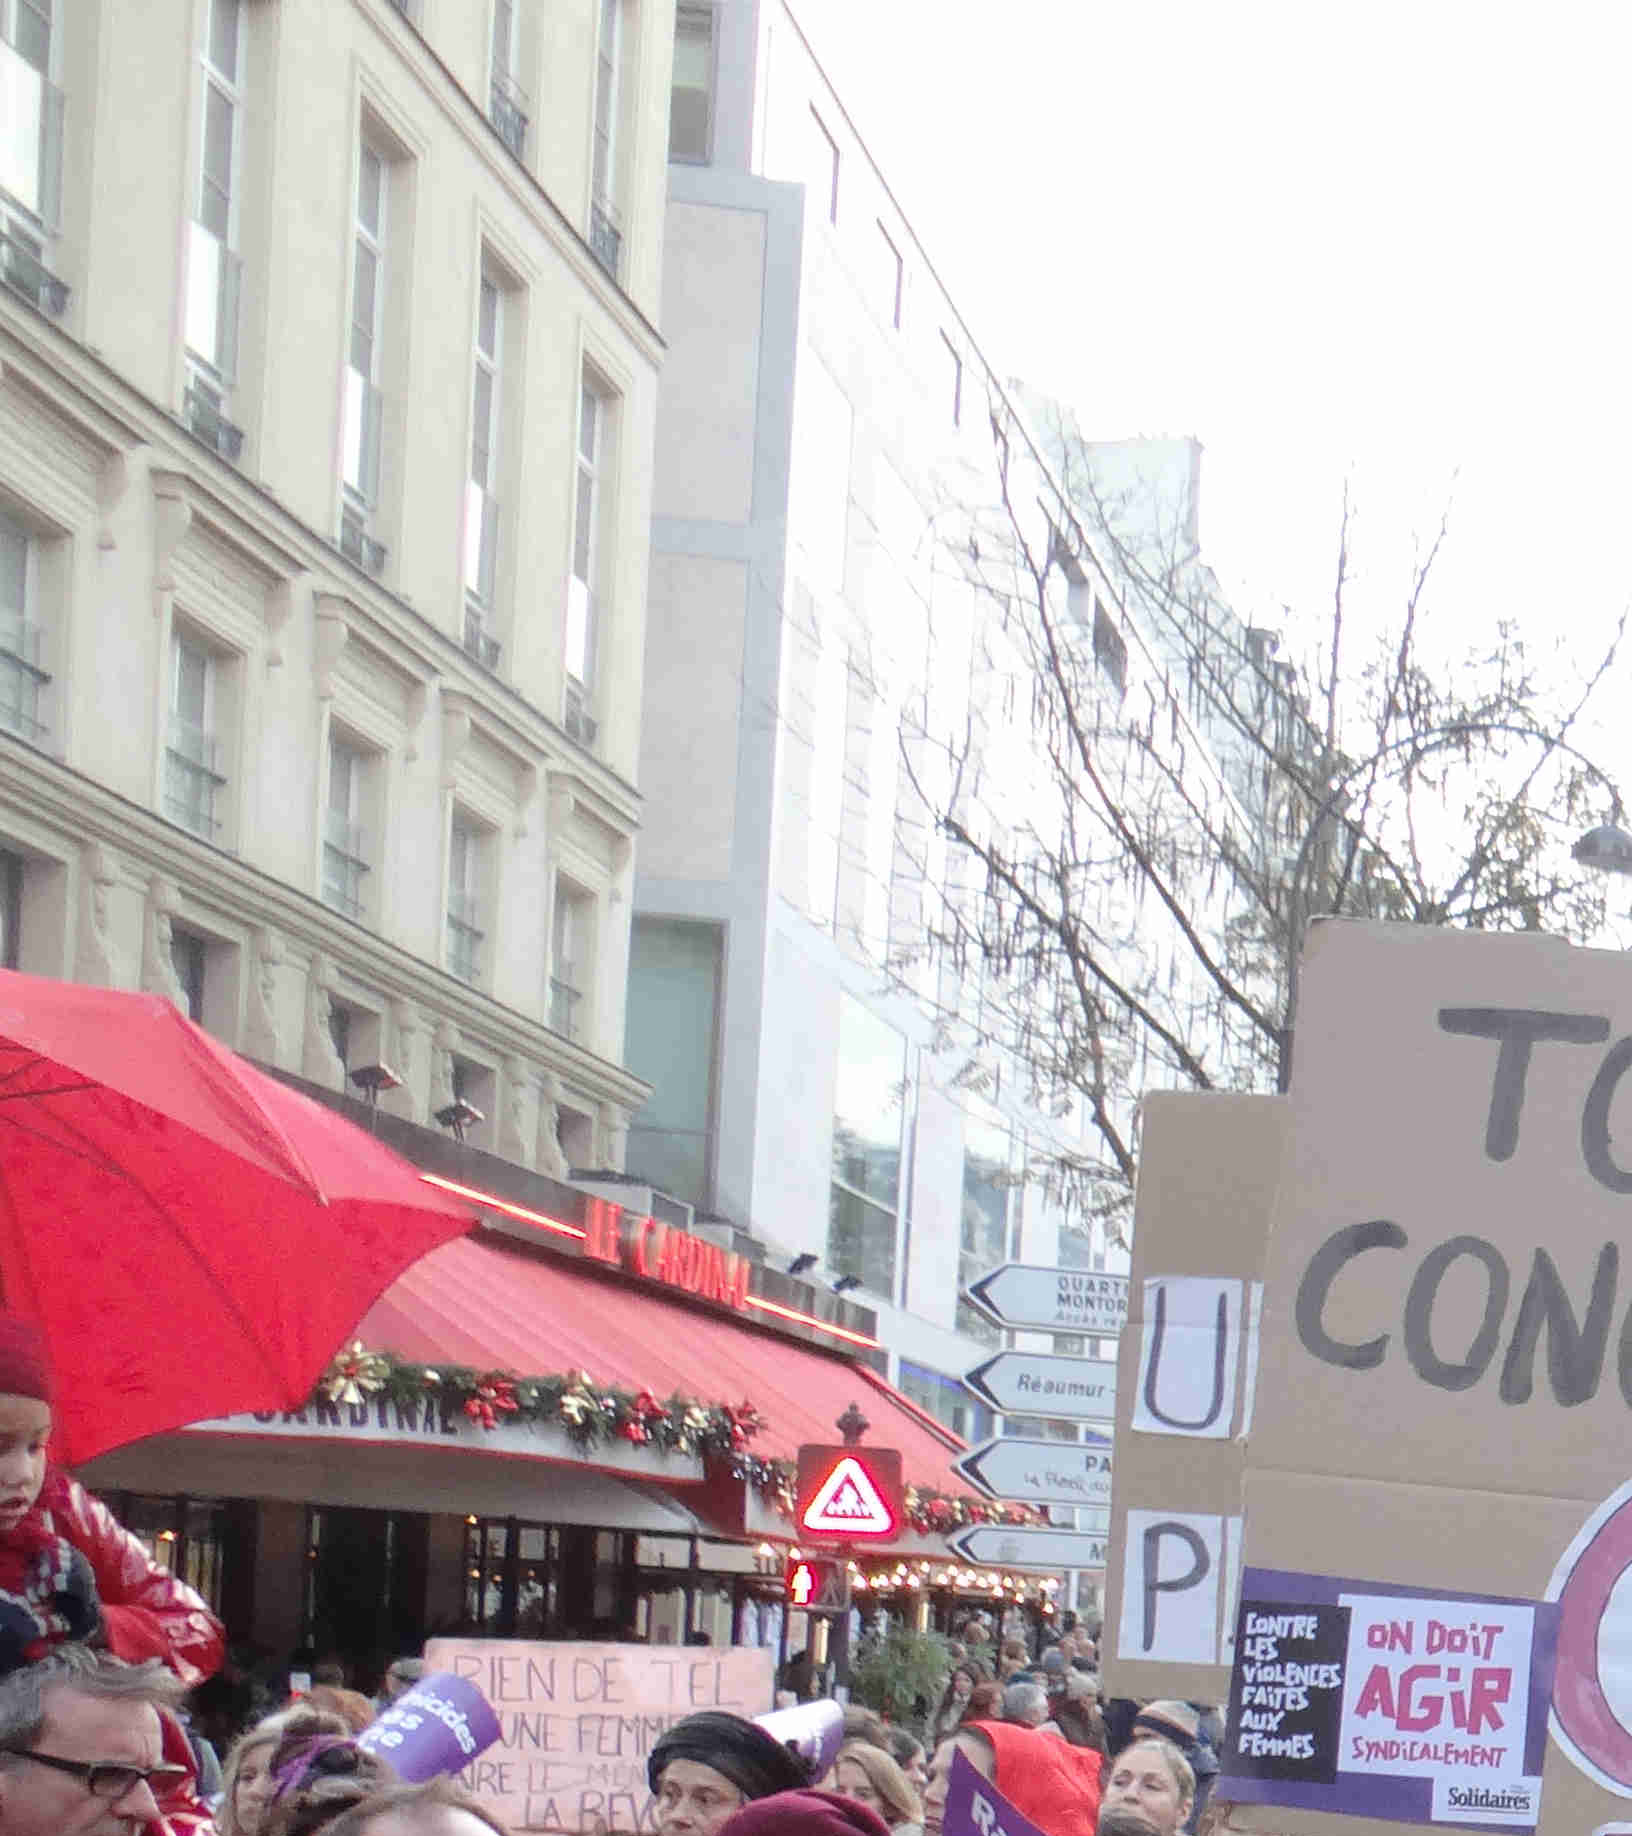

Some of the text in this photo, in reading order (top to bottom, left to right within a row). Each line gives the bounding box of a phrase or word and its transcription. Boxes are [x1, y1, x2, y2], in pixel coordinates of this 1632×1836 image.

[585, 1198, 622, 1265] LE
[1246, 1612, 1318, 1641] CONTRE
[1243, 1637, 1279, 1662] LES
[573, 1657, 625, 1704] DE
[650, 1657, 743, 1707] TEL
[1239, 1709, 1286, 1732] AUX
[1238, 1732, 1316, 1759] FEMMES
[524, 1795, 562, 1829] LA
[1448, 1786, 1531, 1810] Solidaires
